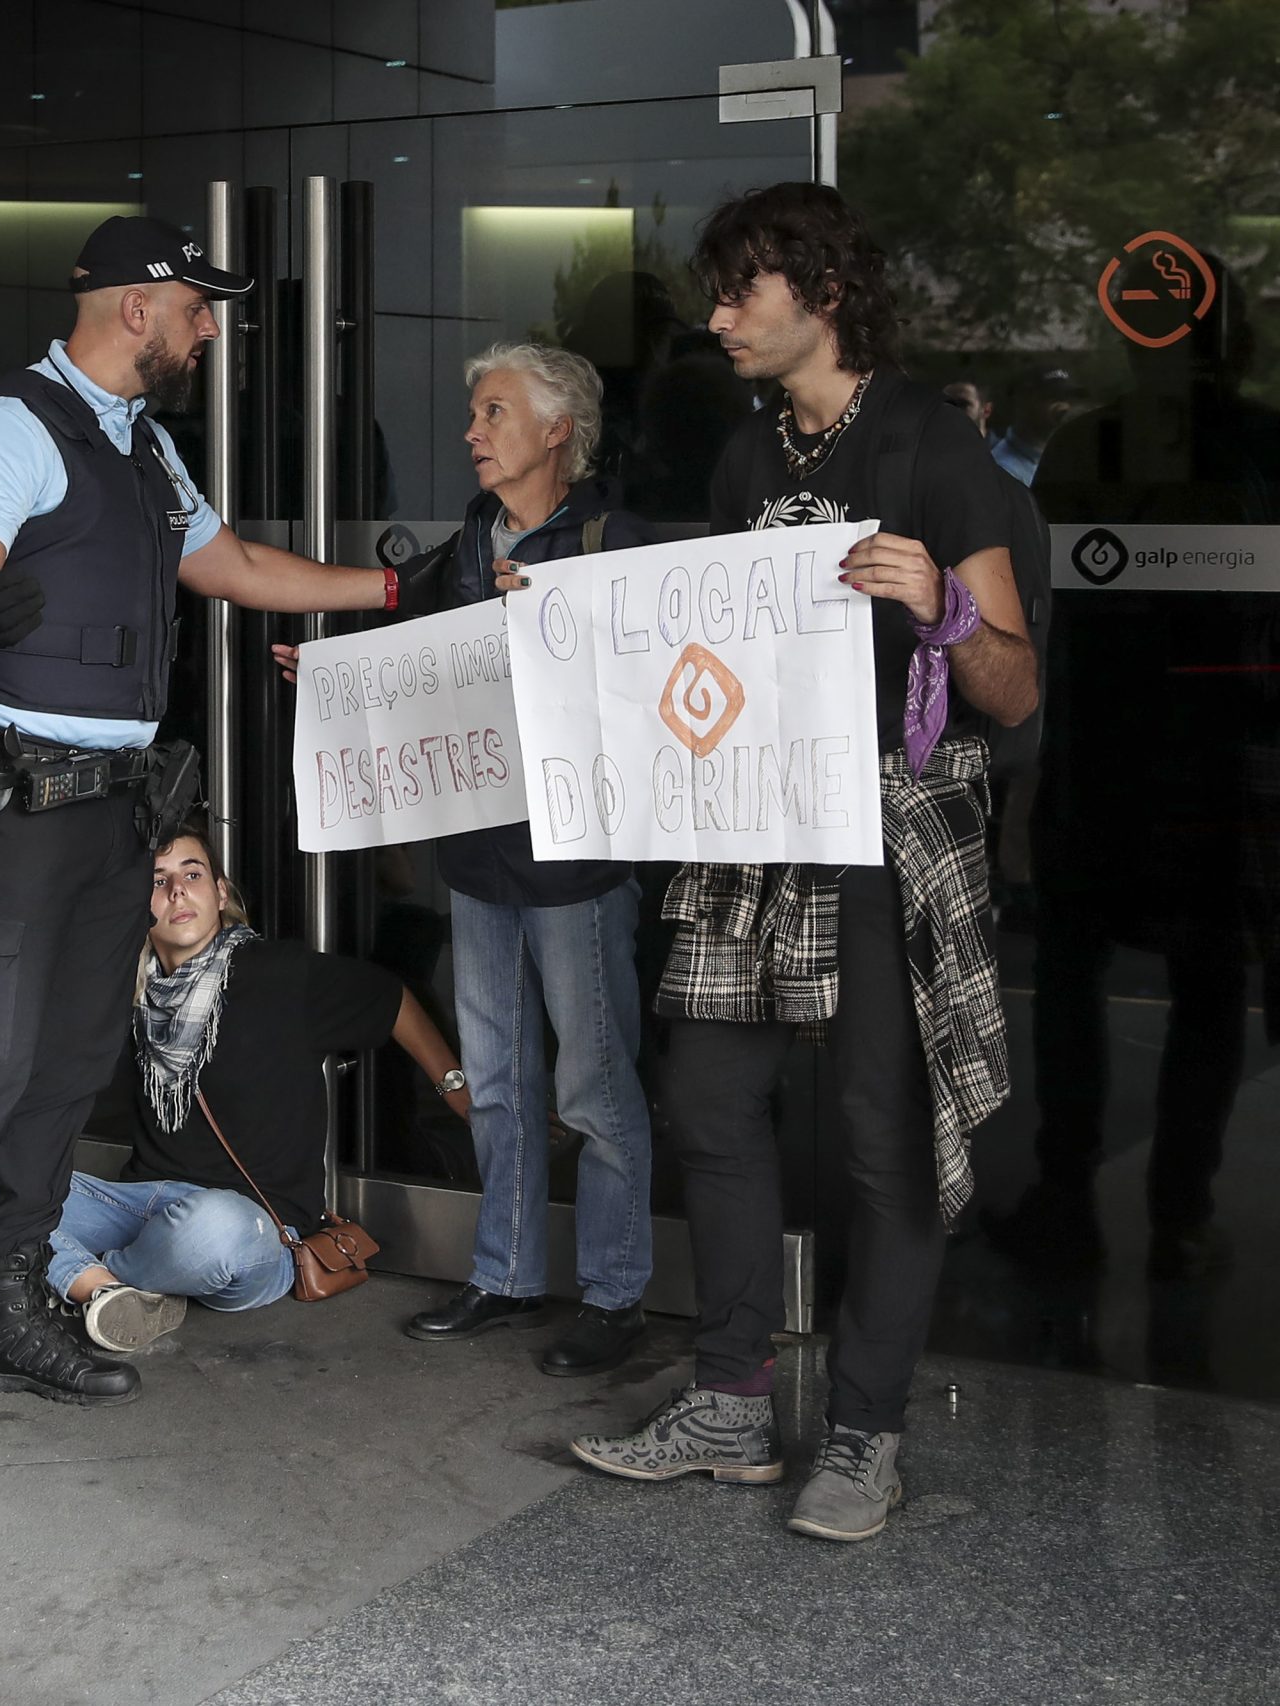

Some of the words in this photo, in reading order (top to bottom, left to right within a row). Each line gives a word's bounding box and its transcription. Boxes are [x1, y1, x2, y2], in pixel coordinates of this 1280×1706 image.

[538, 586, 578, 661] O
[611, 551, 849, 656] LOCAL
[1135, 547, 1178, 568] galp
[1182, 549, 1256, 570] energia
[312, 646, 440, 722] PREÇOS
[315, 728, 511, 830] DESASTRES
[542, 753, 626, 845] DO
[652, 735, 850, 833] CRIME
